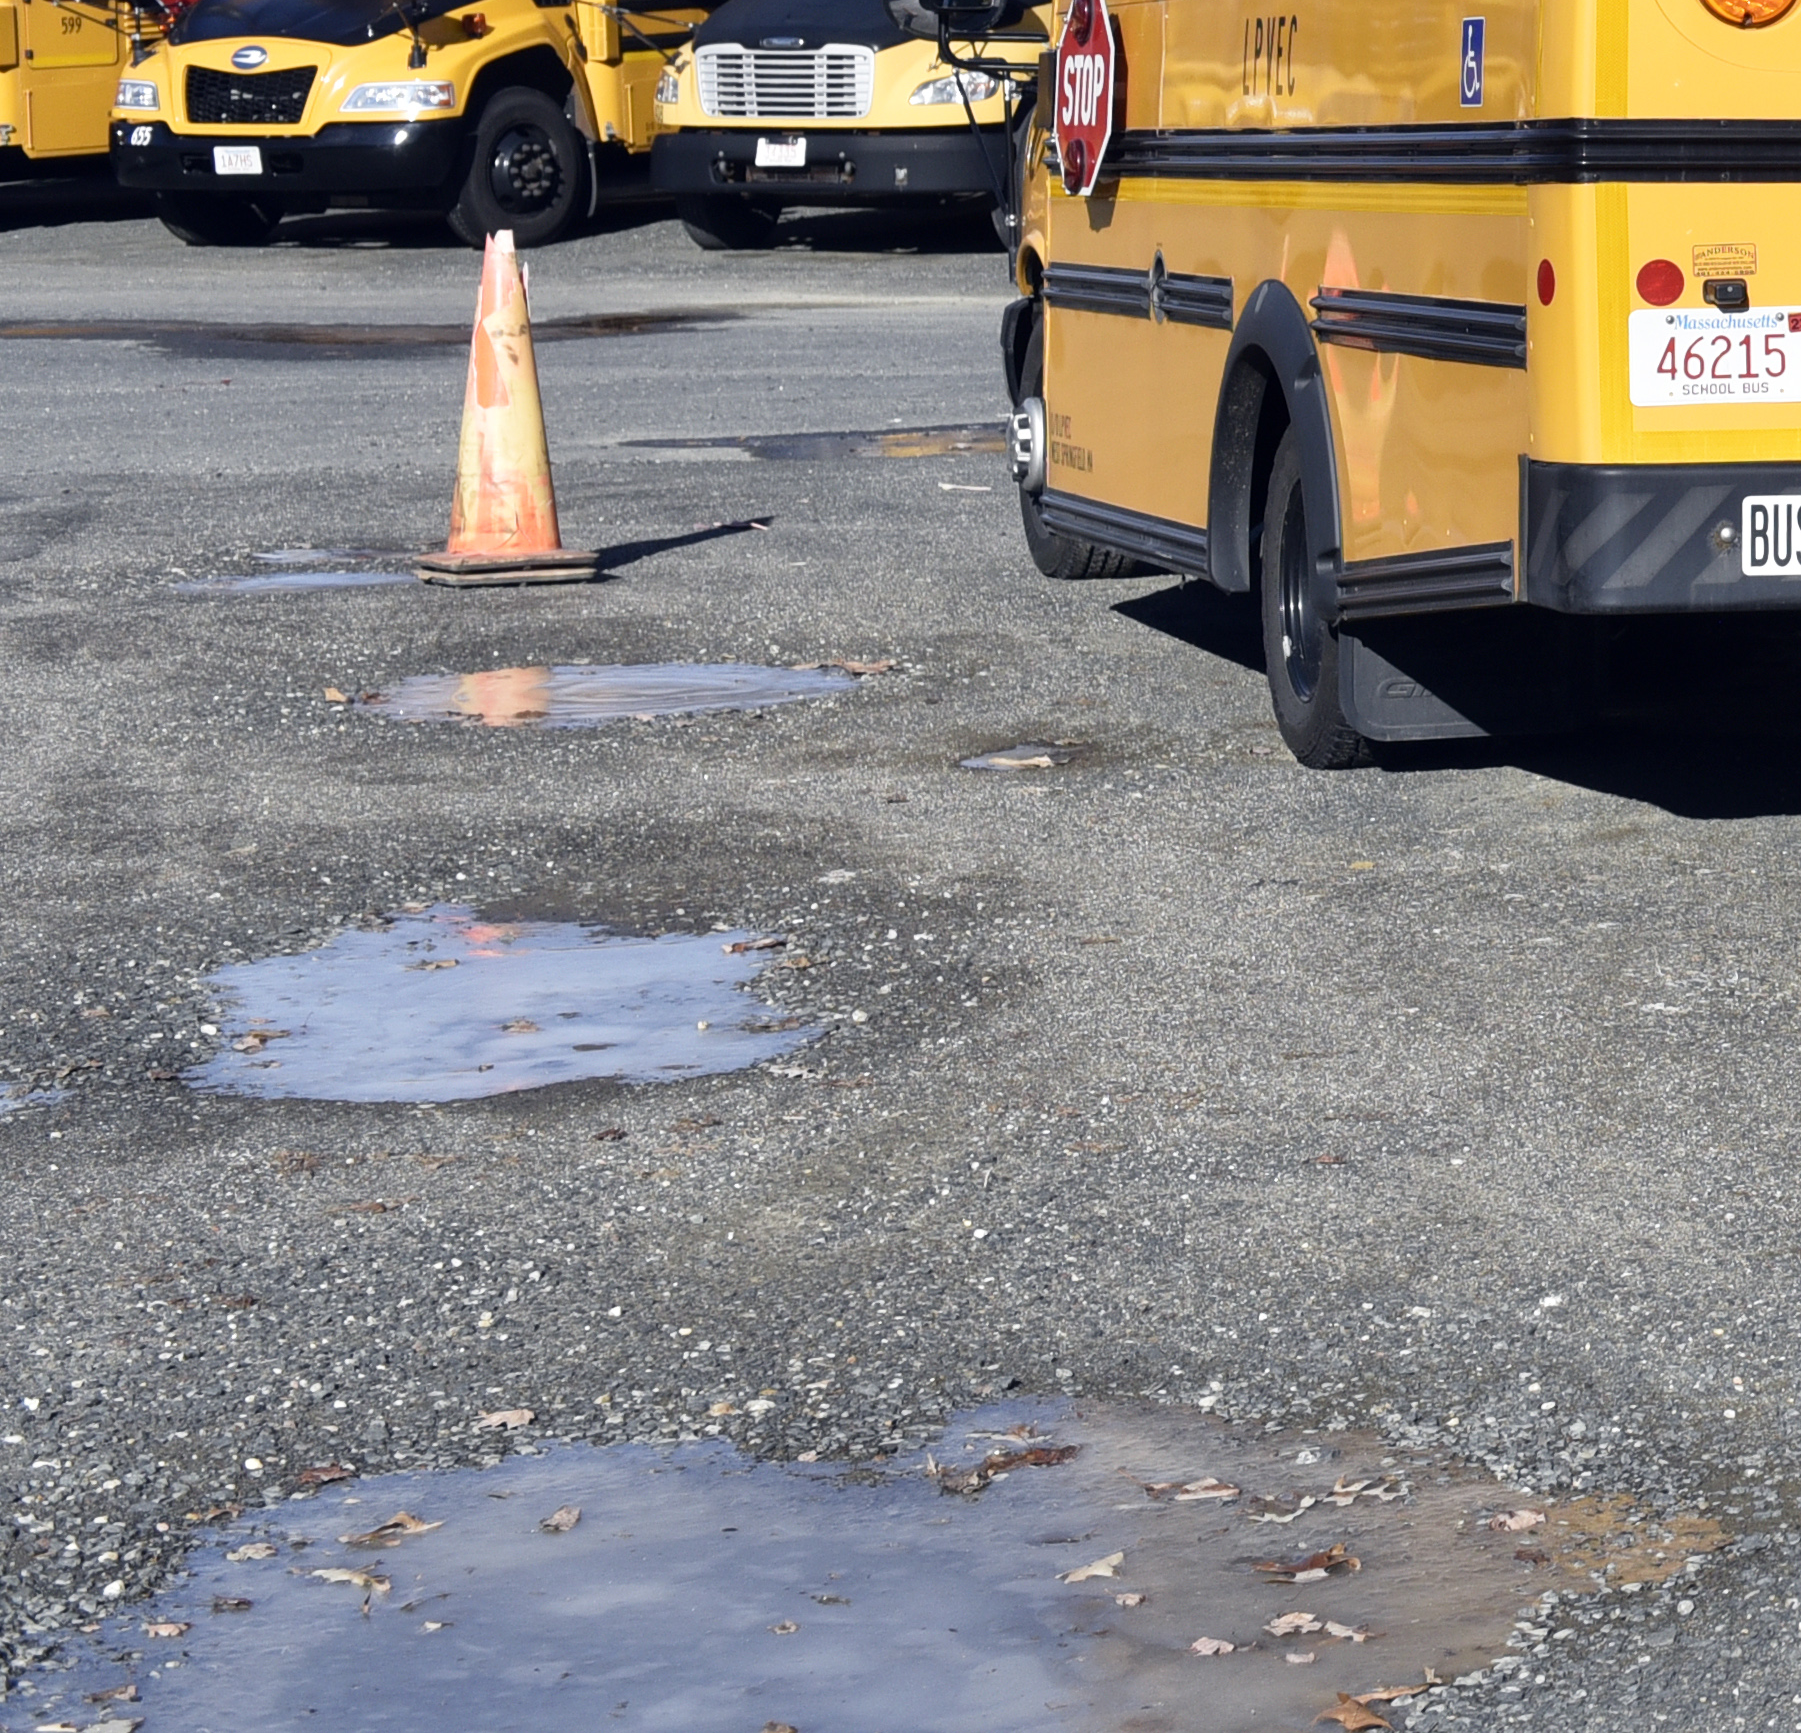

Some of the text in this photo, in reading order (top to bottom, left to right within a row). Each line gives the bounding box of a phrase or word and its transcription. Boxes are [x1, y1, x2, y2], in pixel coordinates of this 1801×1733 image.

[61, 16, 82, 35] 599
[1242, 14, 1298, 97] LPVEC
[1062, 54, 1105, 126] STOP
[130, 126, 153, 146] 655
[1674, 314, 1778, 330] Massachusetts
[1657, 333, 1786, 381] 46215
[1682, 382, 1769, 396] SCHOOL BUS
